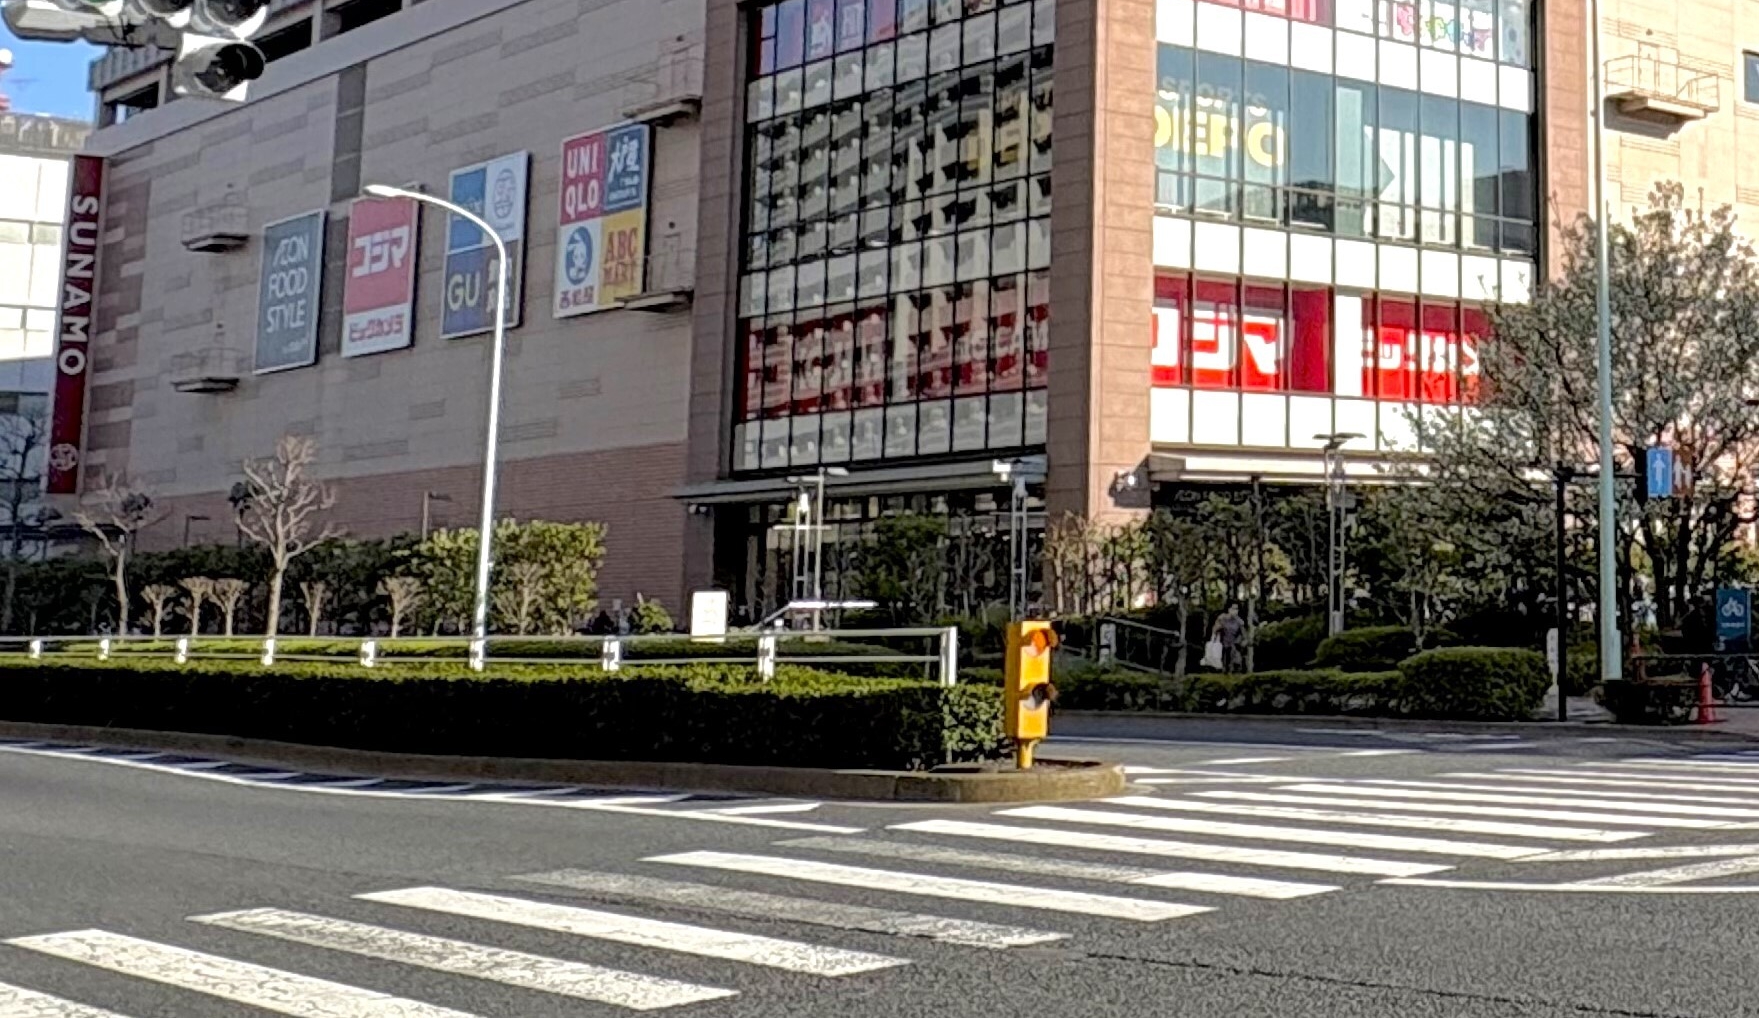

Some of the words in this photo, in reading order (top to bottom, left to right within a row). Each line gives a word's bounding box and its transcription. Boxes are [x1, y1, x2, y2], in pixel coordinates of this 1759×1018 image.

[566, 142, 599, 180] UNI
[564, 178, 600, 220] QLO
[352, 225, 411, 279] コジマ
[605, 228, 638, 263] ABC
[58, 194, 99, 376] SUNAMO
[269, 267, 308, 300] FOOD
[447, 271, 481, 312] GU
[266, 299, 307, 334] STYLE
